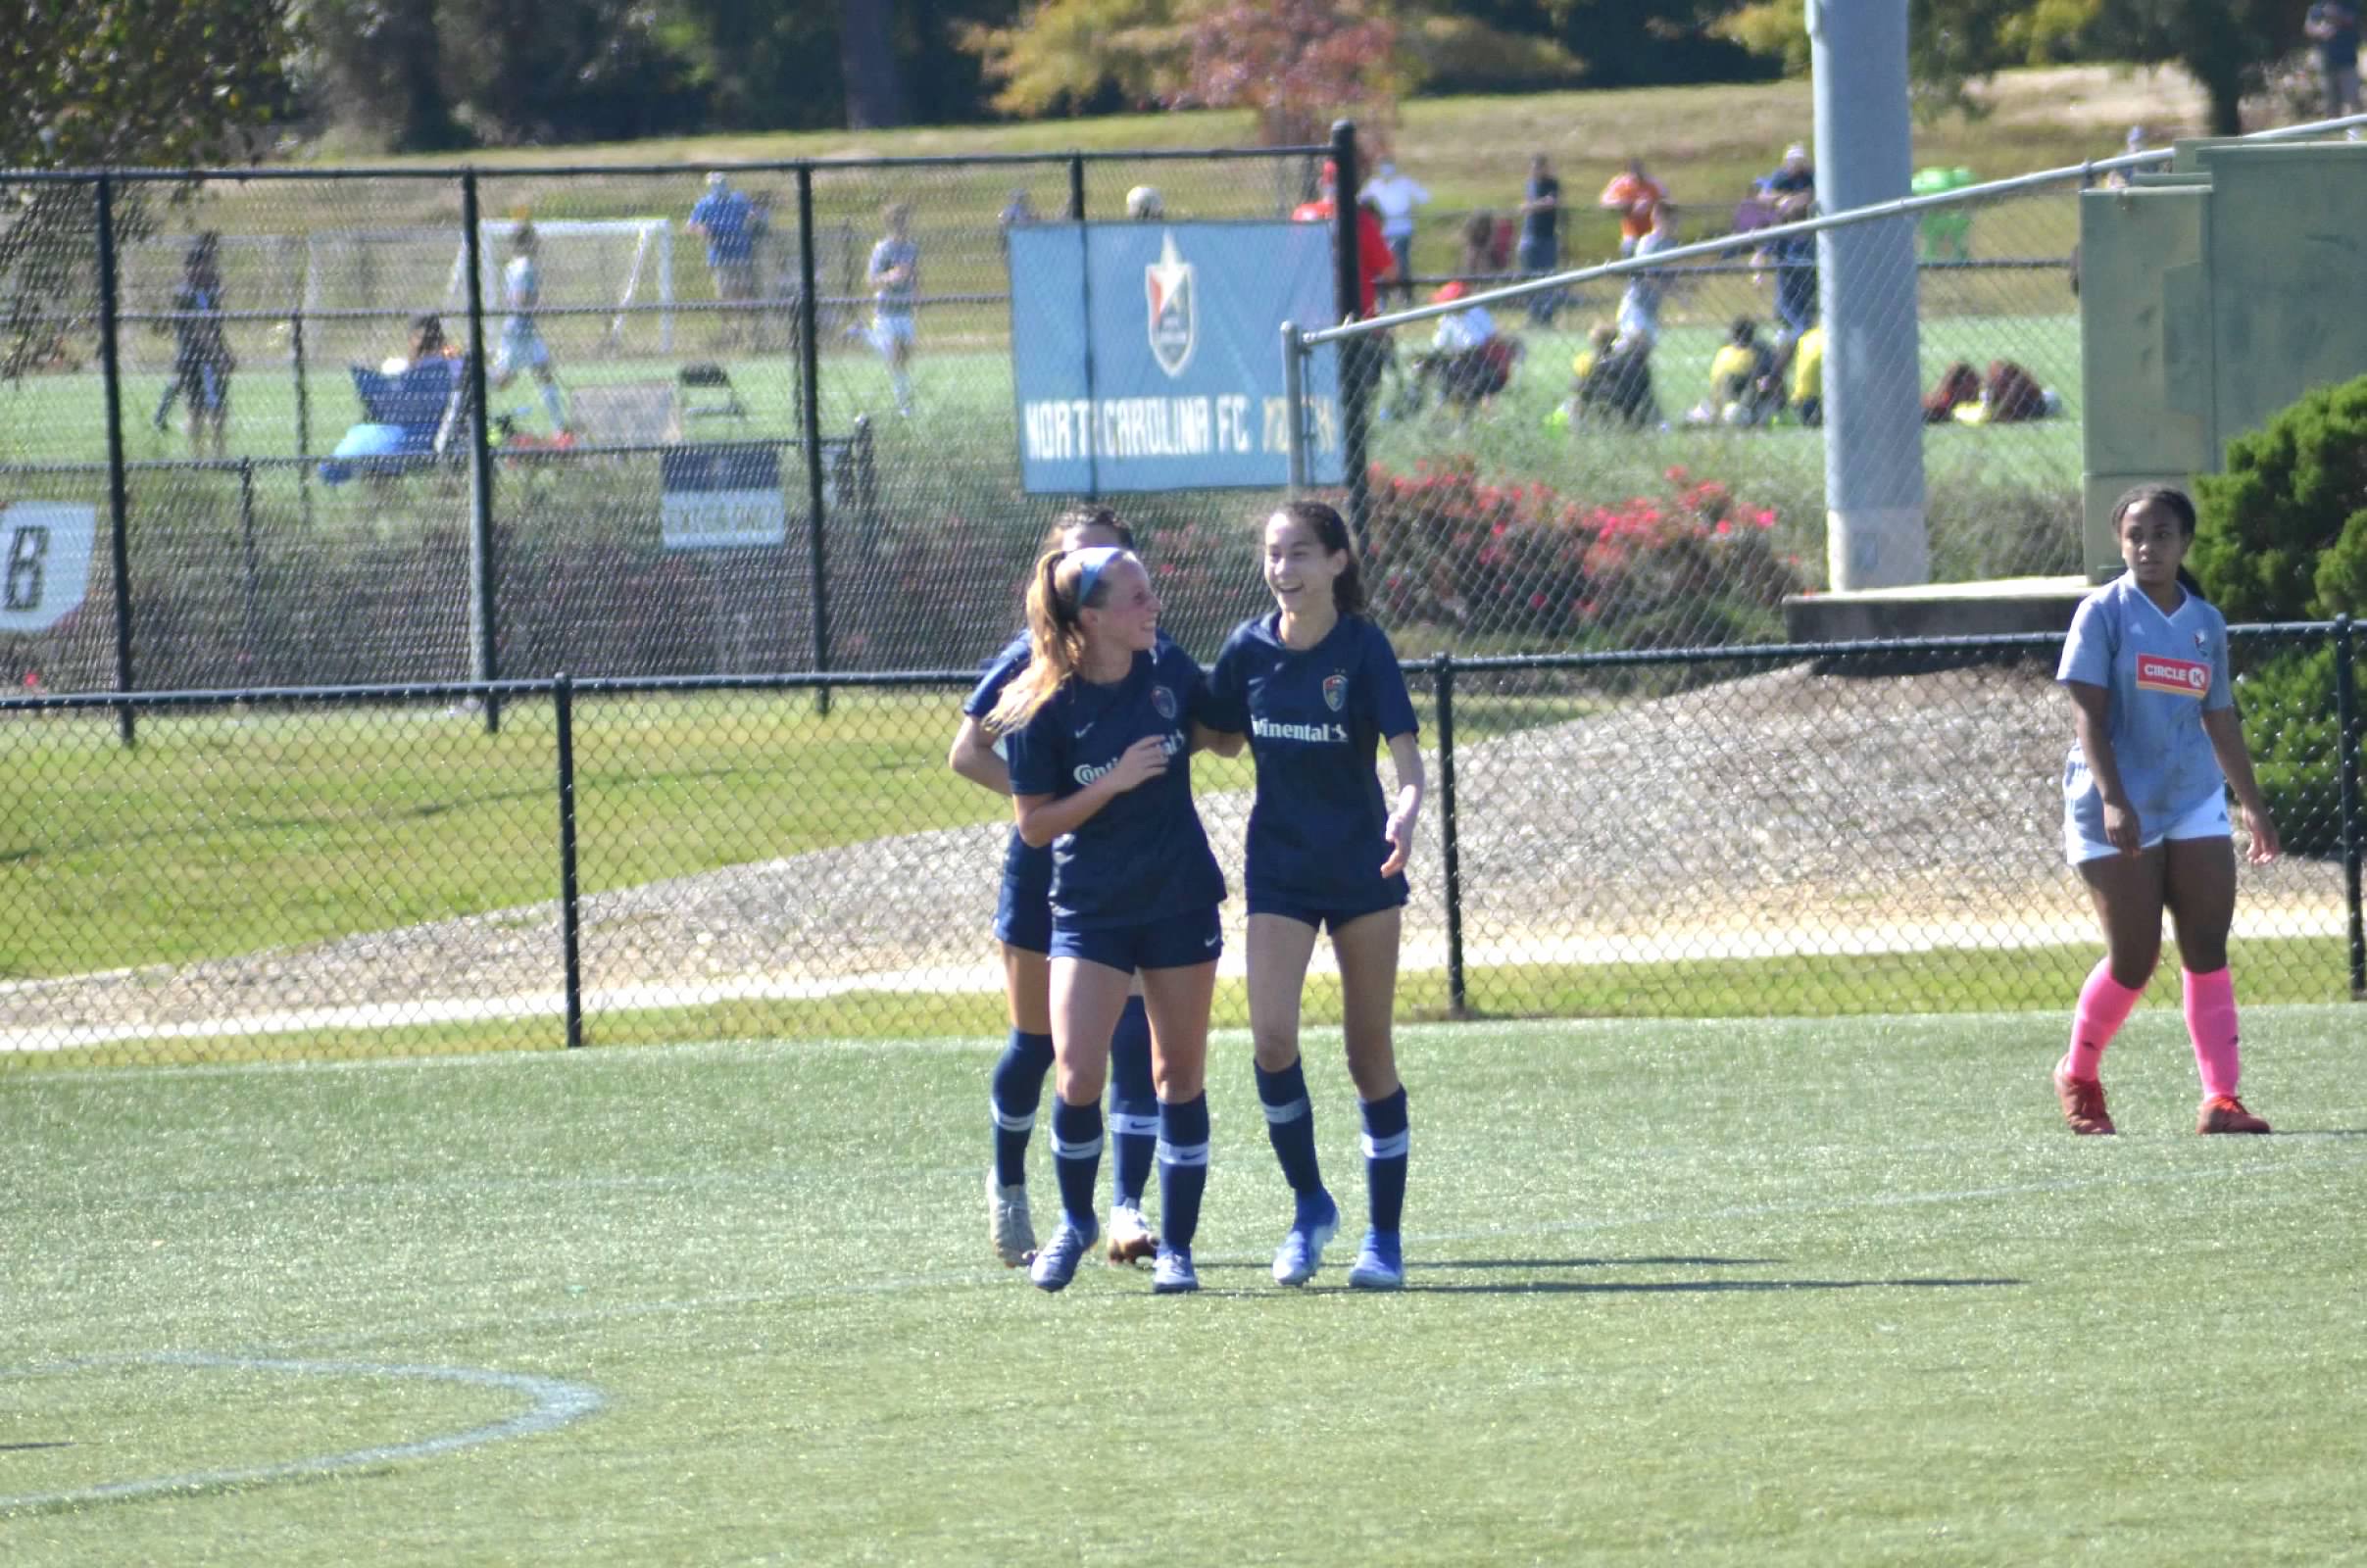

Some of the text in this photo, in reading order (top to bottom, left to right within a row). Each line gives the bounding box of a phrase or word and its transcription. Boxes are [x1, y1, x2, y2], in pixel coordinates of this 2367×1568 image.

[1103, 396, 1209, 456] CAROLINA
[1215, 394, 1249, 452] FC
[2145, 663, 2187, 680] CIRCLE
